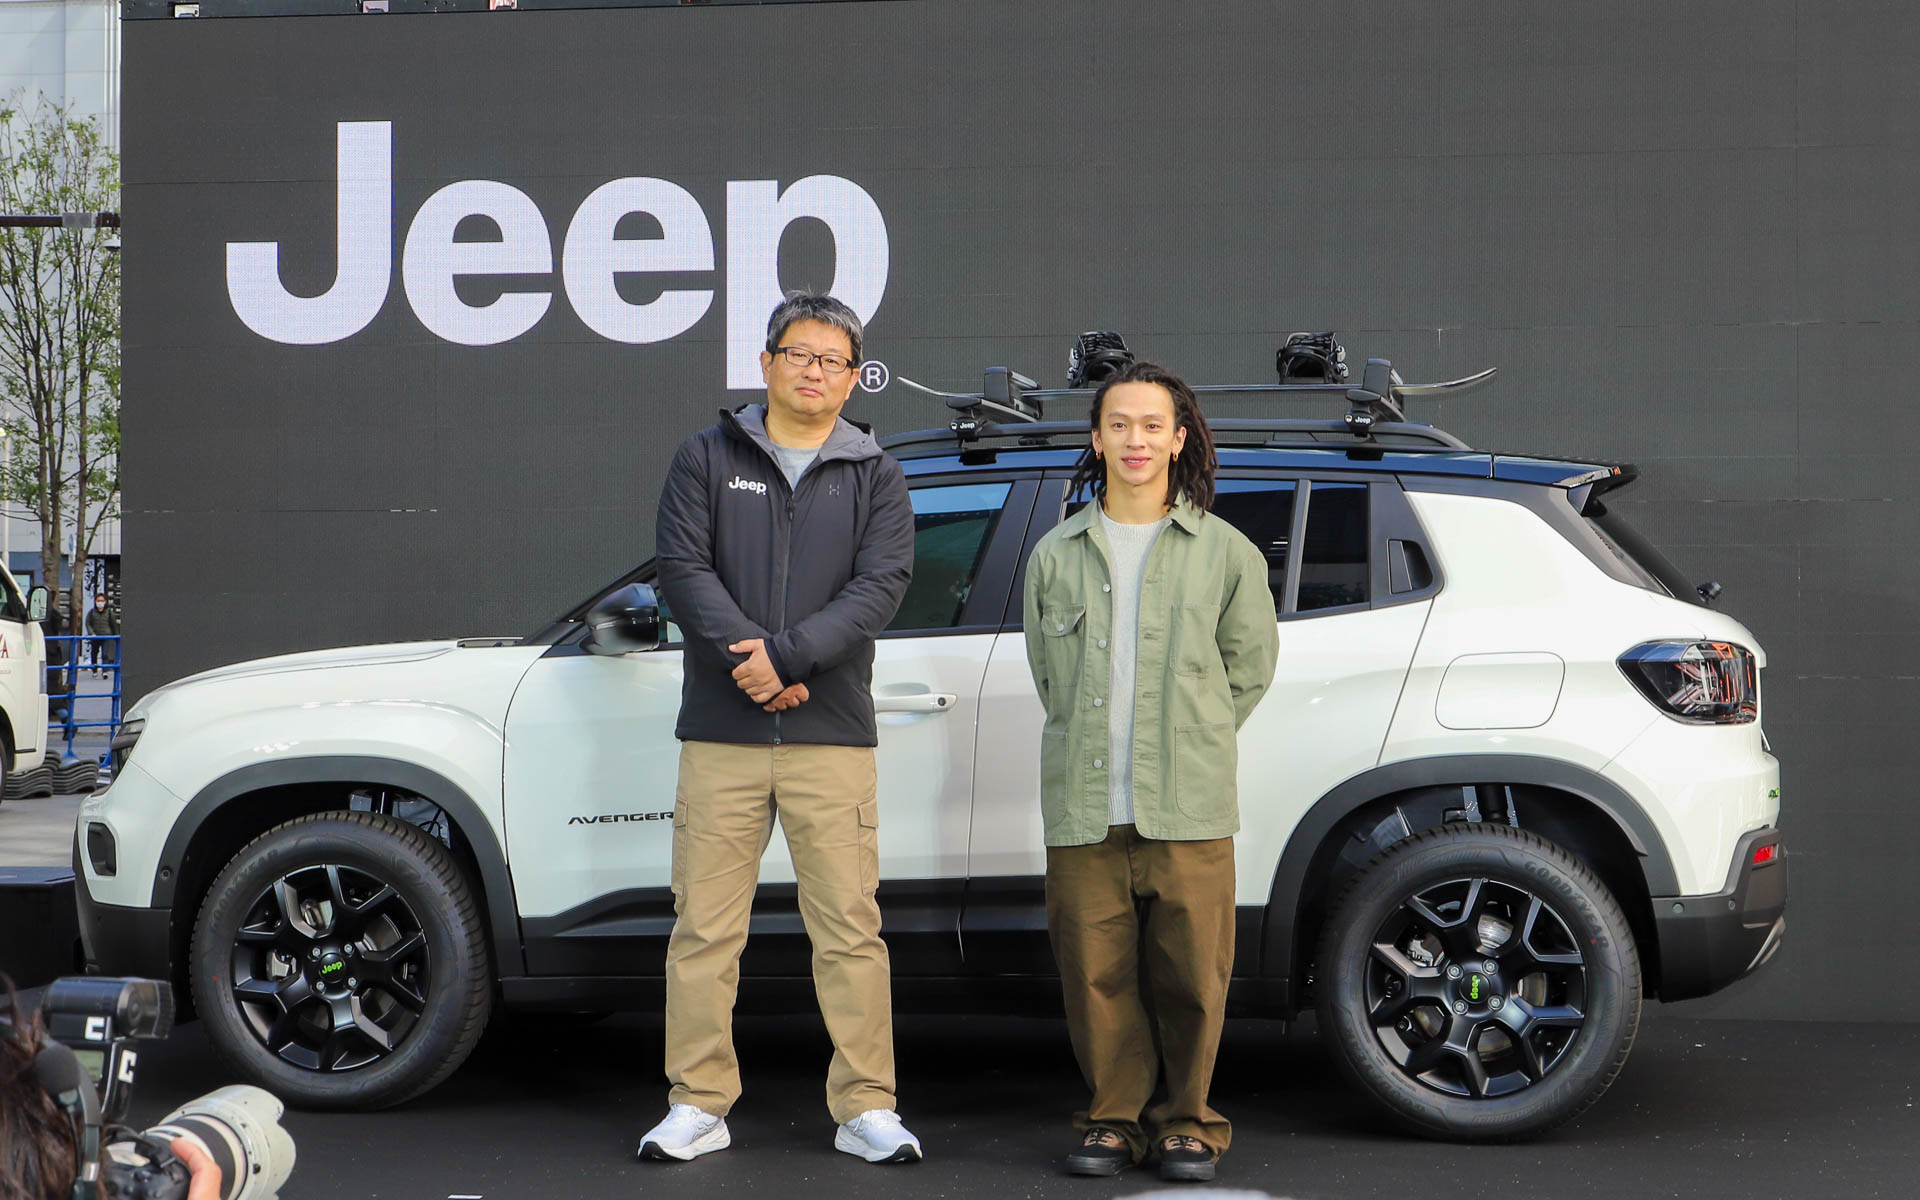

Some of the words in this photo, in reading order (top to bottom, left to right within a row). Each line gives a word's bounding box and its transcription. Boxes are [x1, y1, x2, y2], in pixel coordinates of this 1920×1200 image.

[225, 120, 890, 390] Jeep
[1354, 415, 1371, 425] Jeep
[728, 475, 767, 495] Jeep
[567, 811, 674, 825] AVENGER
[1524, 860, 1610, 949] GOODYEAR
[322, 961, 343, 974] Jeep
[1469, 974, 1481, 999] Jeep
